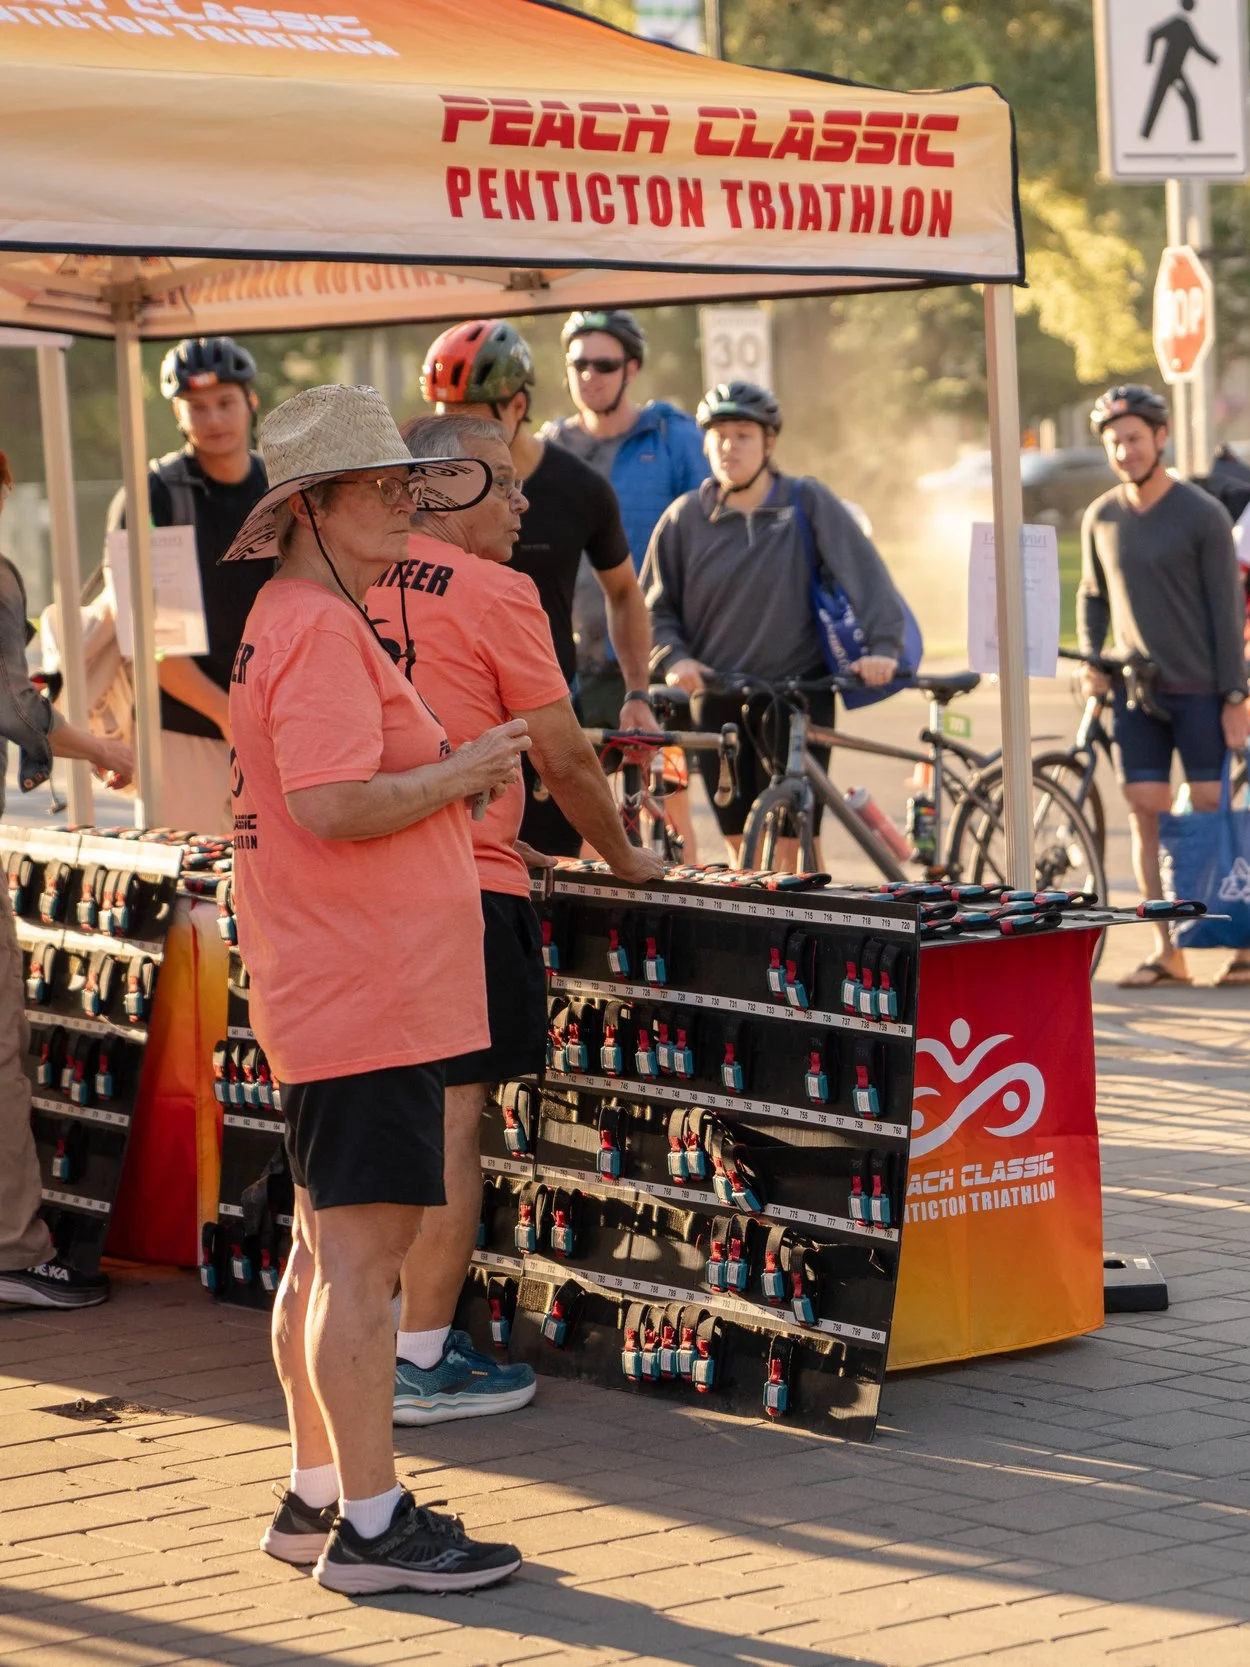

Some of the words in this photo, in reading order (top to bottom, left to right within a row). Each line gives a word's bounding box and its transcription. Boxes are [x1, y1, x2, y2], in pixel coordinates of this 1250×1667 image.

[126, 0, 371, 36] CLASSIC
[173, 23, 401, 57] TRIATHLON
[438, 94, 671, 154] PEACH
[694, 106, 960, 168] CLASSIC
[446, 166, 704, 228] PENTICTON
[720, 179, 953, 238] TRIATHLON
[712, 332, 762, 370] 30
[824, 913, 832, 921] 716
[862, 917, 870, 925] 718
[902, 921, 910, 929] 720
[785, 1009, 793, 1017] 734
[861, 1021, 869, 1029] 738
[906, 1168, 954, 1197] ACH
[960, 1152, 1054, 1188] CLASSIC
[969, 1180, 1056, 1212] TRIATHLON
[866, 1226, 874, 1234] 779
[853, 1327, 861, 1336] 799
